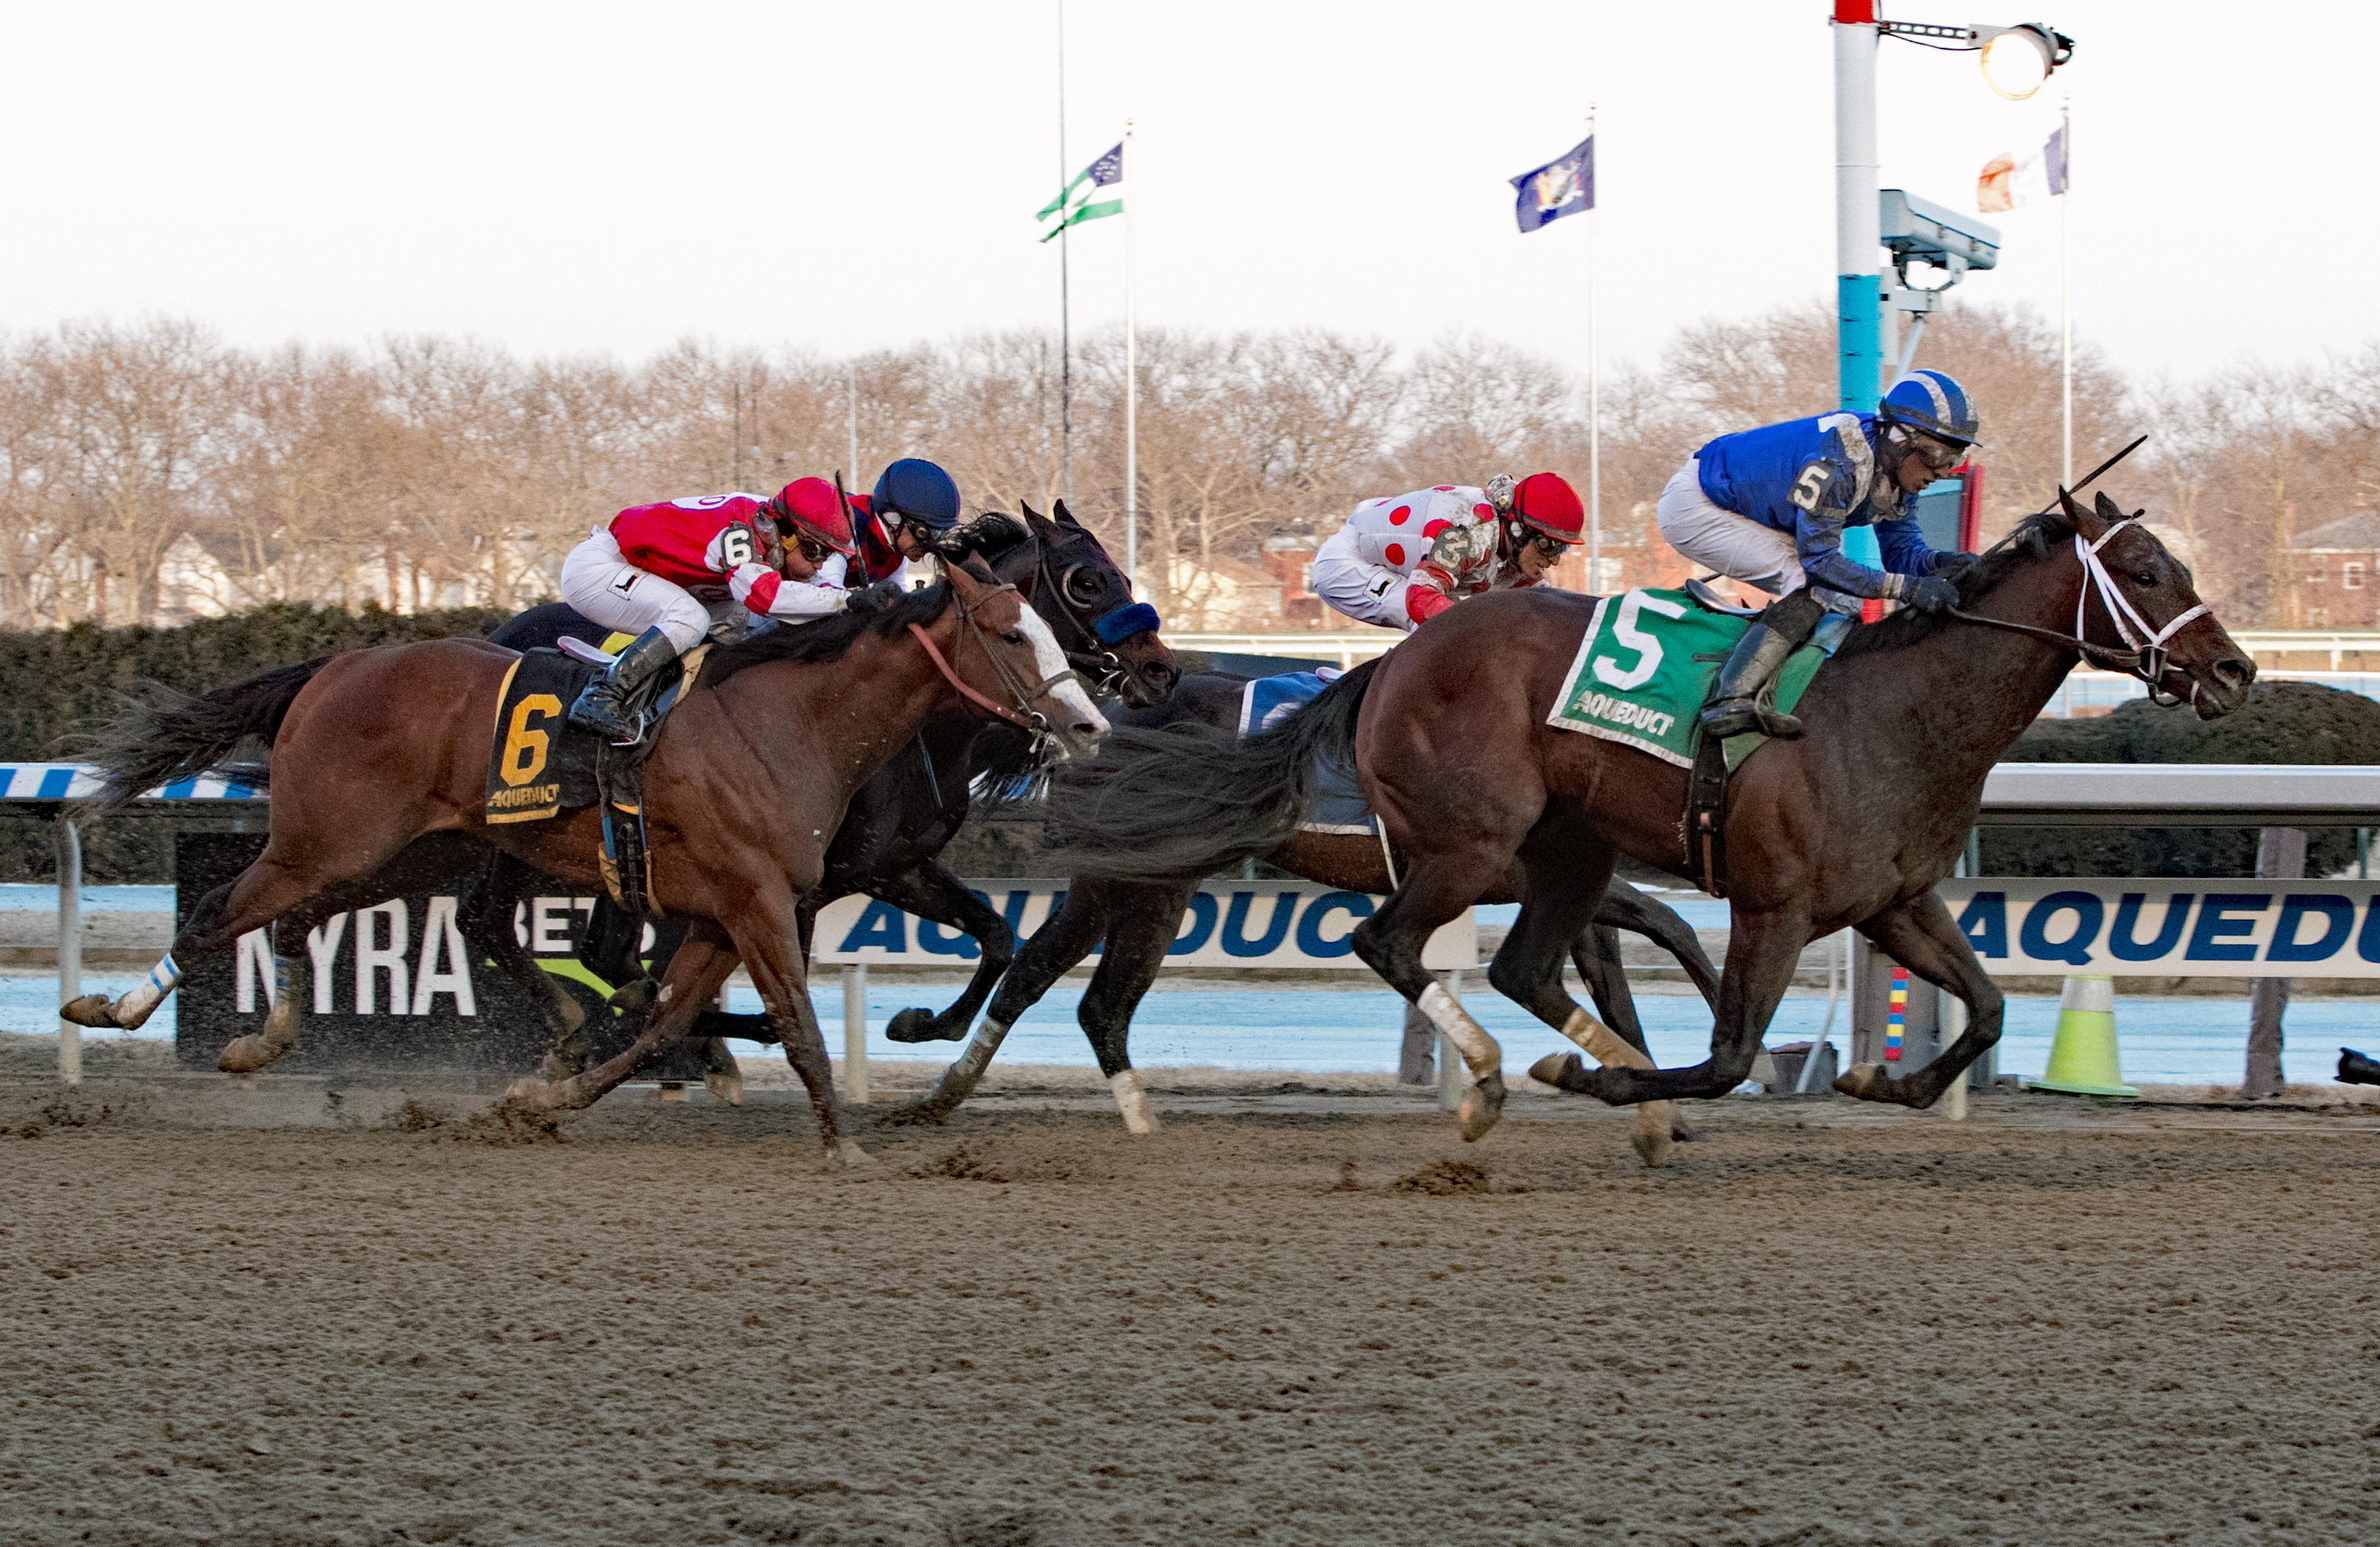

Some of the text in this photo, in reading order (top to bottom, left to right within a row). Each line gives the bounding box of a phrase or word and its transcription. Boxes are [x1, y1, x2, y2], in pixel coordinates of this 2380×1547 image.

[1793, 465, 1830, 510] 5
[724, 529, 753, 567] 6
[1592, 585, 1688, 691] 5
[1571, 690, 1675, 737] AQUEDUCT
[499, 694, 563, 787] 6
[487, 783, 560, 808] AQUEDUCT
[236, 896, 477, 1016] NYRA
